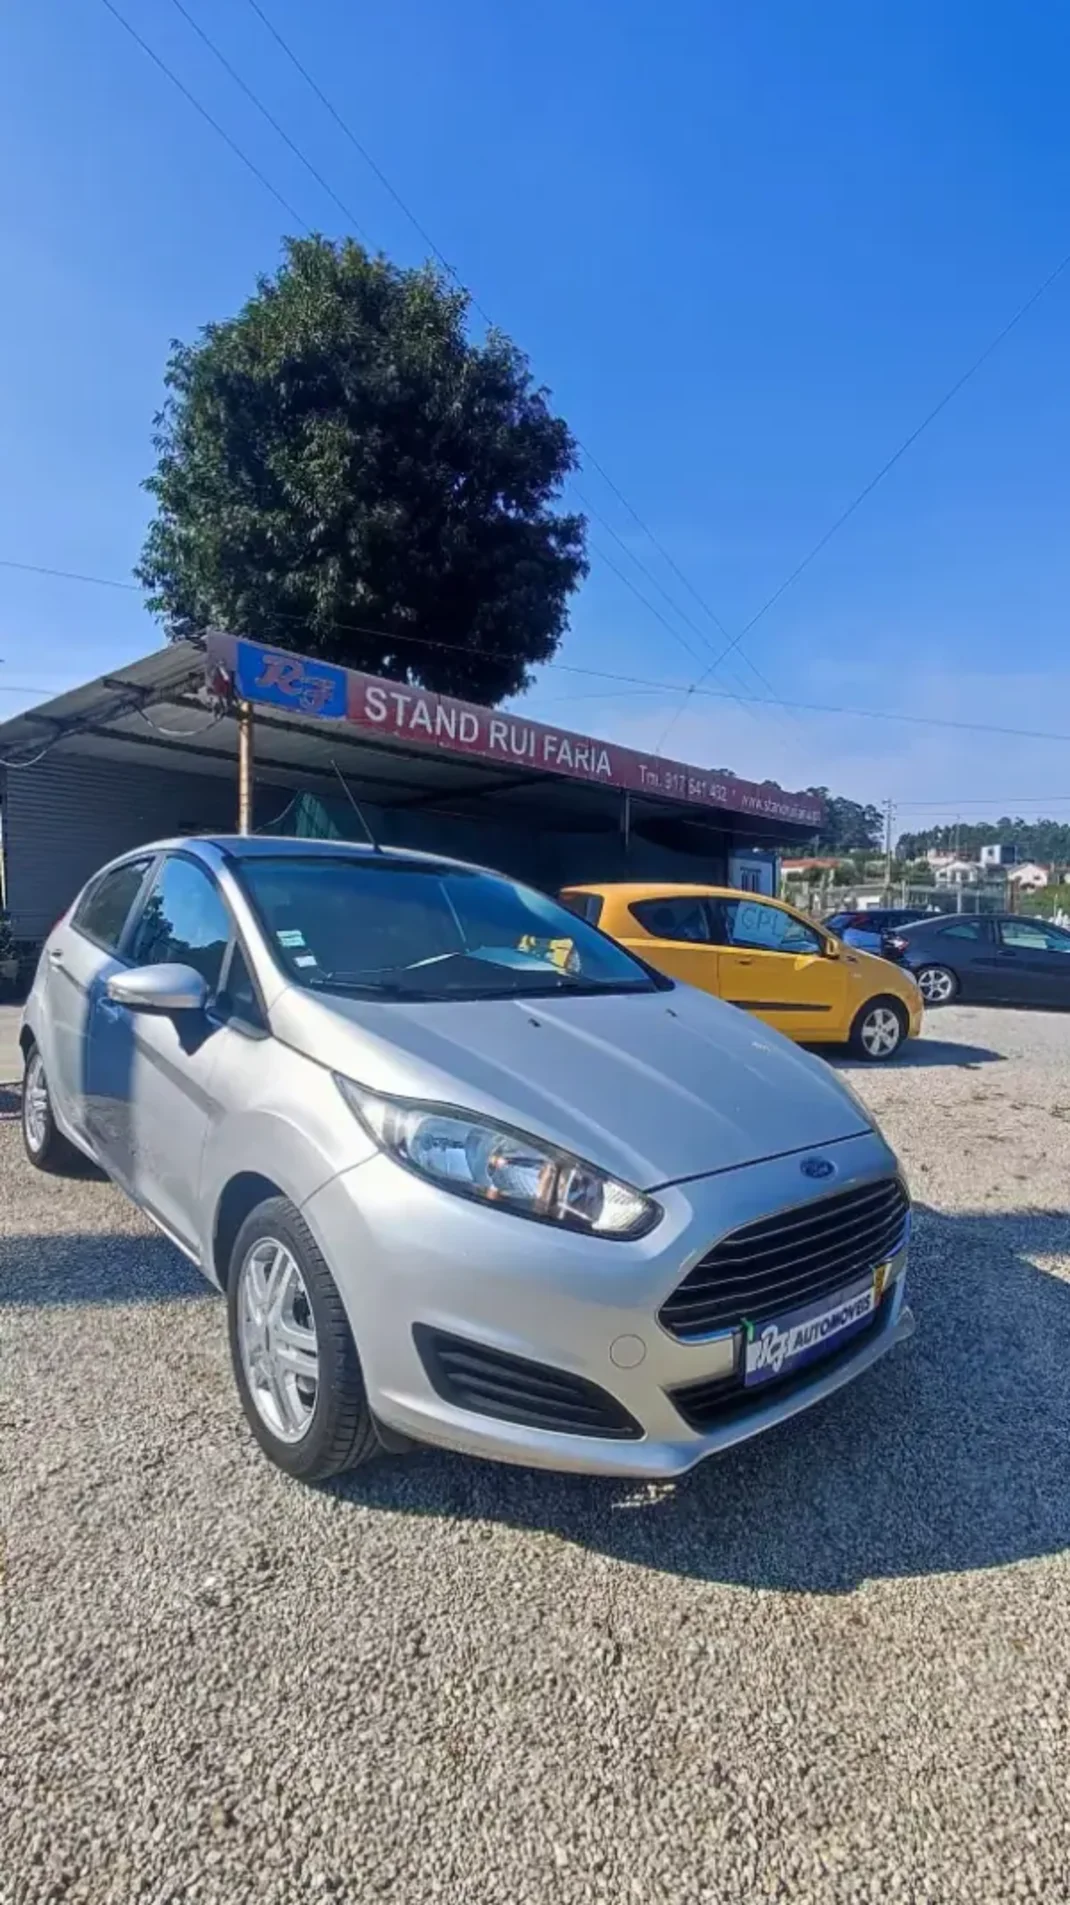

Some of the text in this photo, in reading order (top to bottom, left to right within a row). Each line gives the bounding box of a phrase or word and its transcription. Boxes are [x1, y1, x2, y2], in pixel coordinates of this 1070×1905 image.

[364, 686, 613, 777] STAND RUI FARIA
